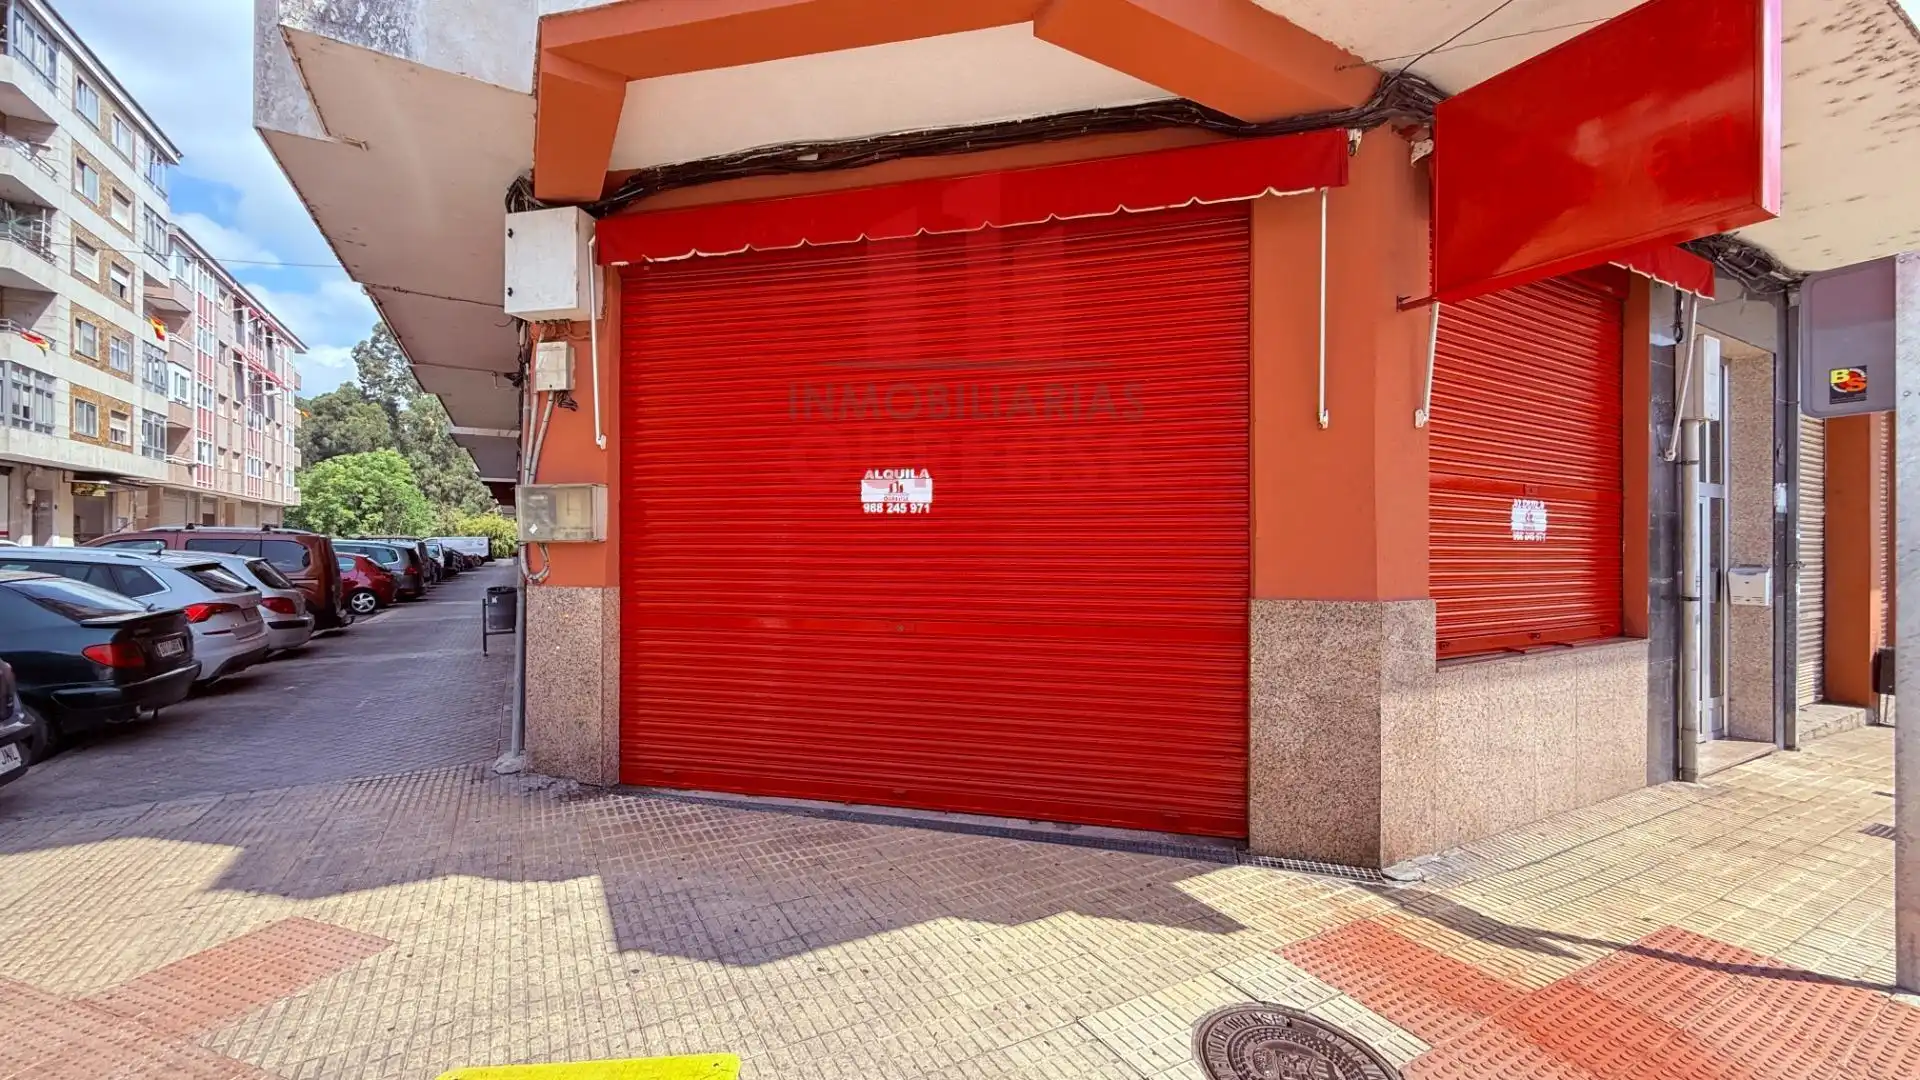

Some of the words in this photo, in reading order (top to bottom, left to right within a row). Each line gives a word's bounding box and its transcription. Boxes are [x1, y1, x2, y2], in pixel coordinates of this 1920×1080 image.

[864, 468, 930, 479] ALQUILA
[886, 503, 908, 513] 245
[910, 503, 931, 513] 971
